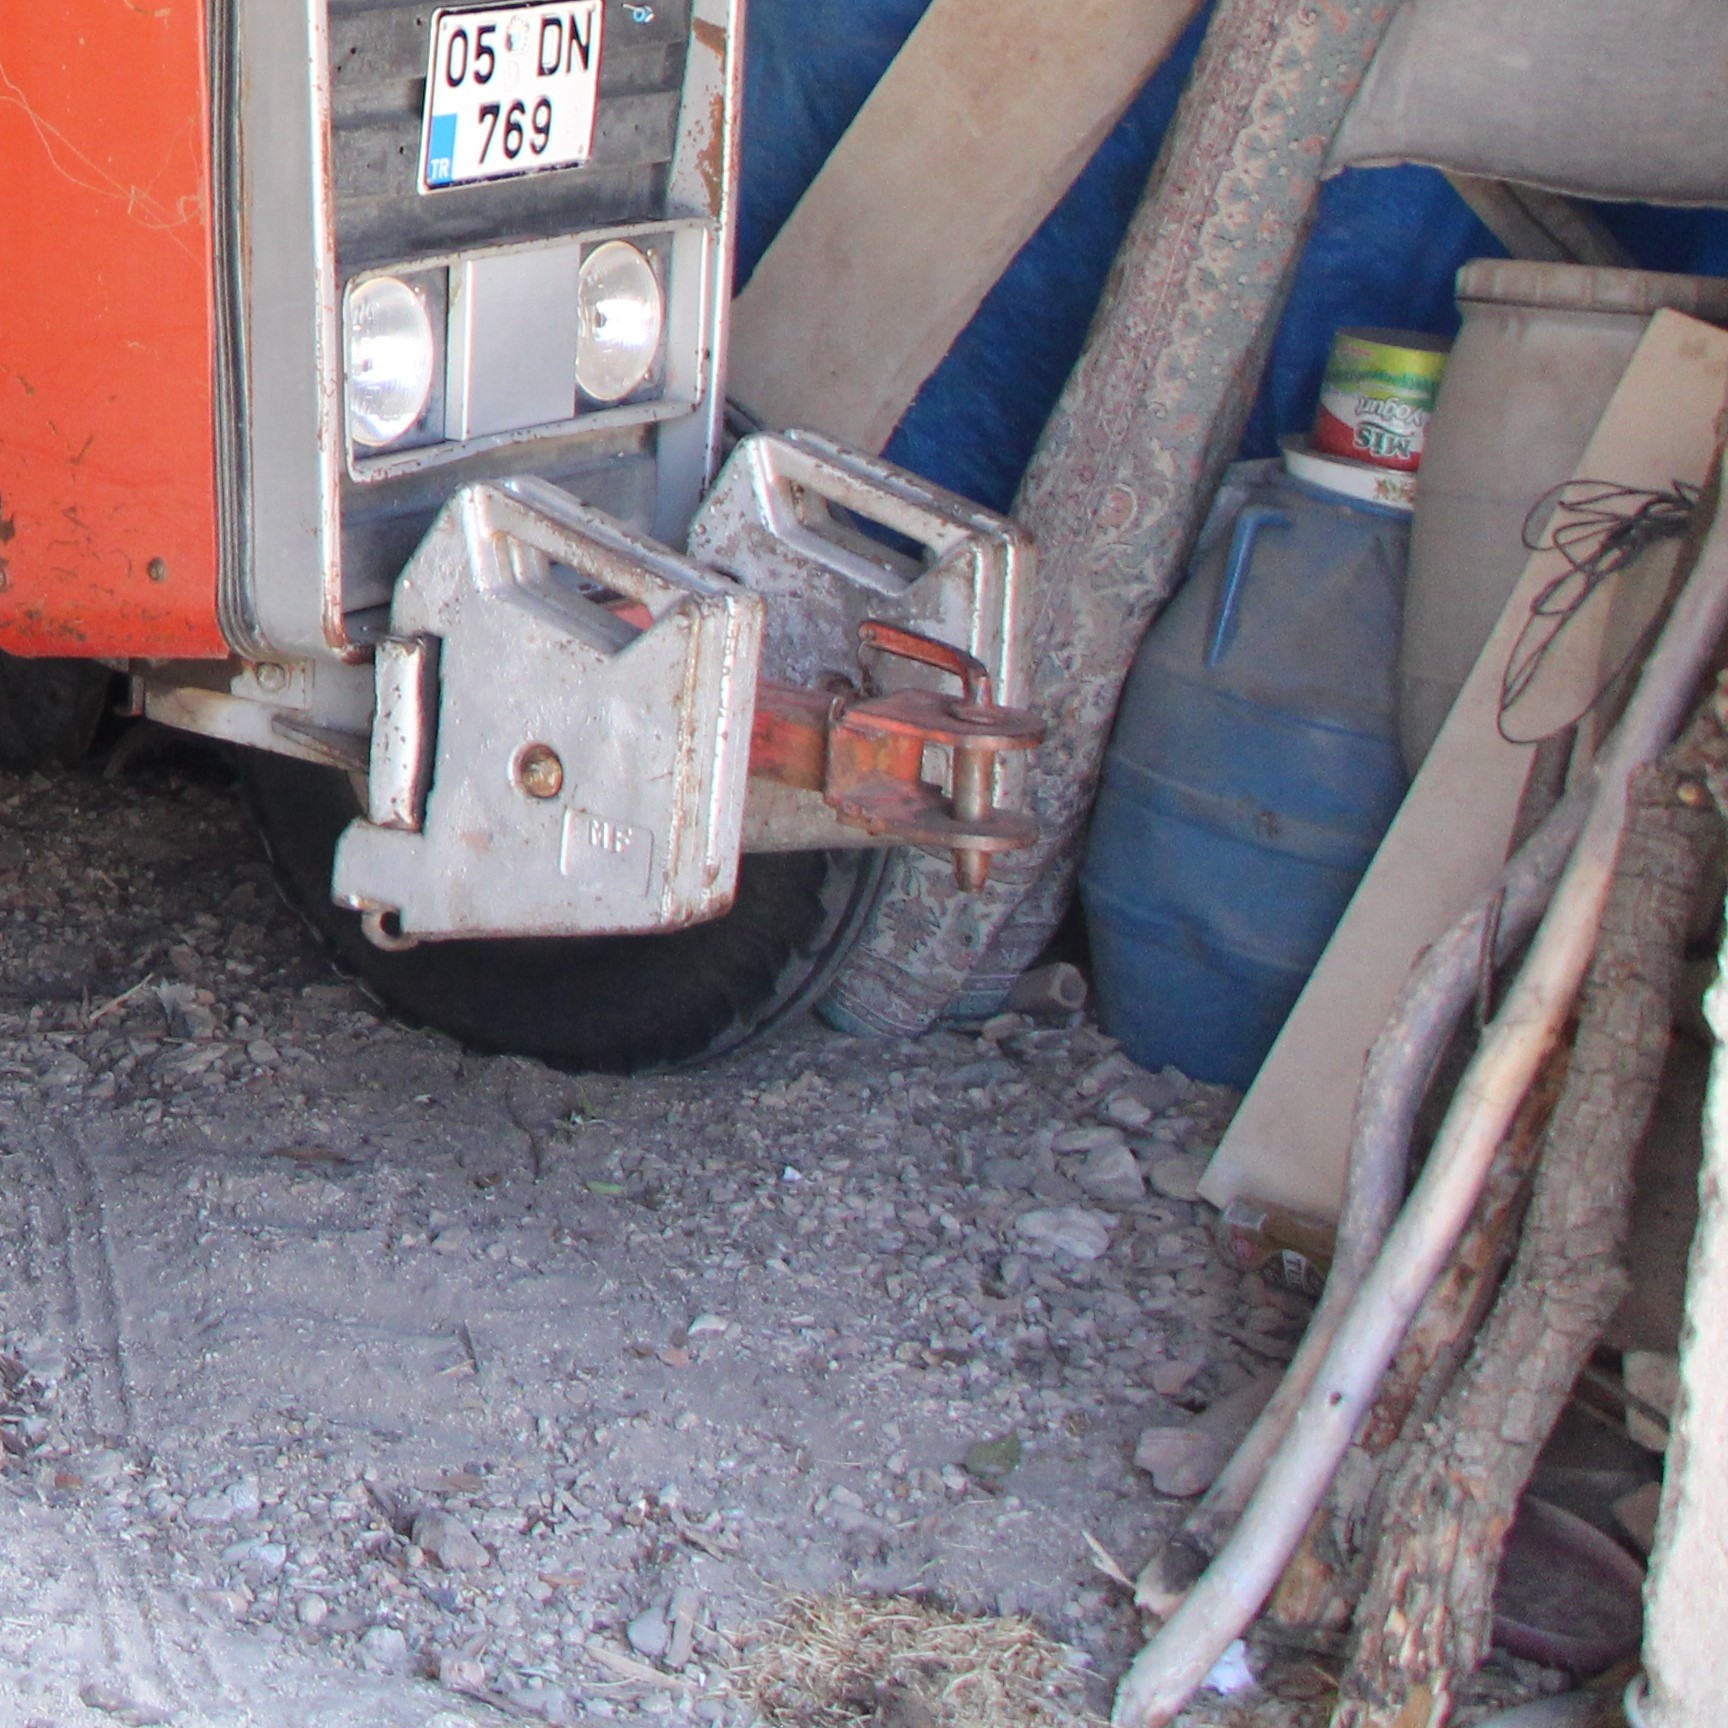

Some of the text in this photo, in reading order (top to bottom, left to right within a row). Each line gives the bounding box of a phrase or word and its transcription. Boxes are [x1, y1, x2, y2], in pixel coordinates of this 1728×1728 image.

[445, 9, 593, 88] 05 DN
[477, 94, 553, 165] 769
[429, 157, 451, 180] TR
